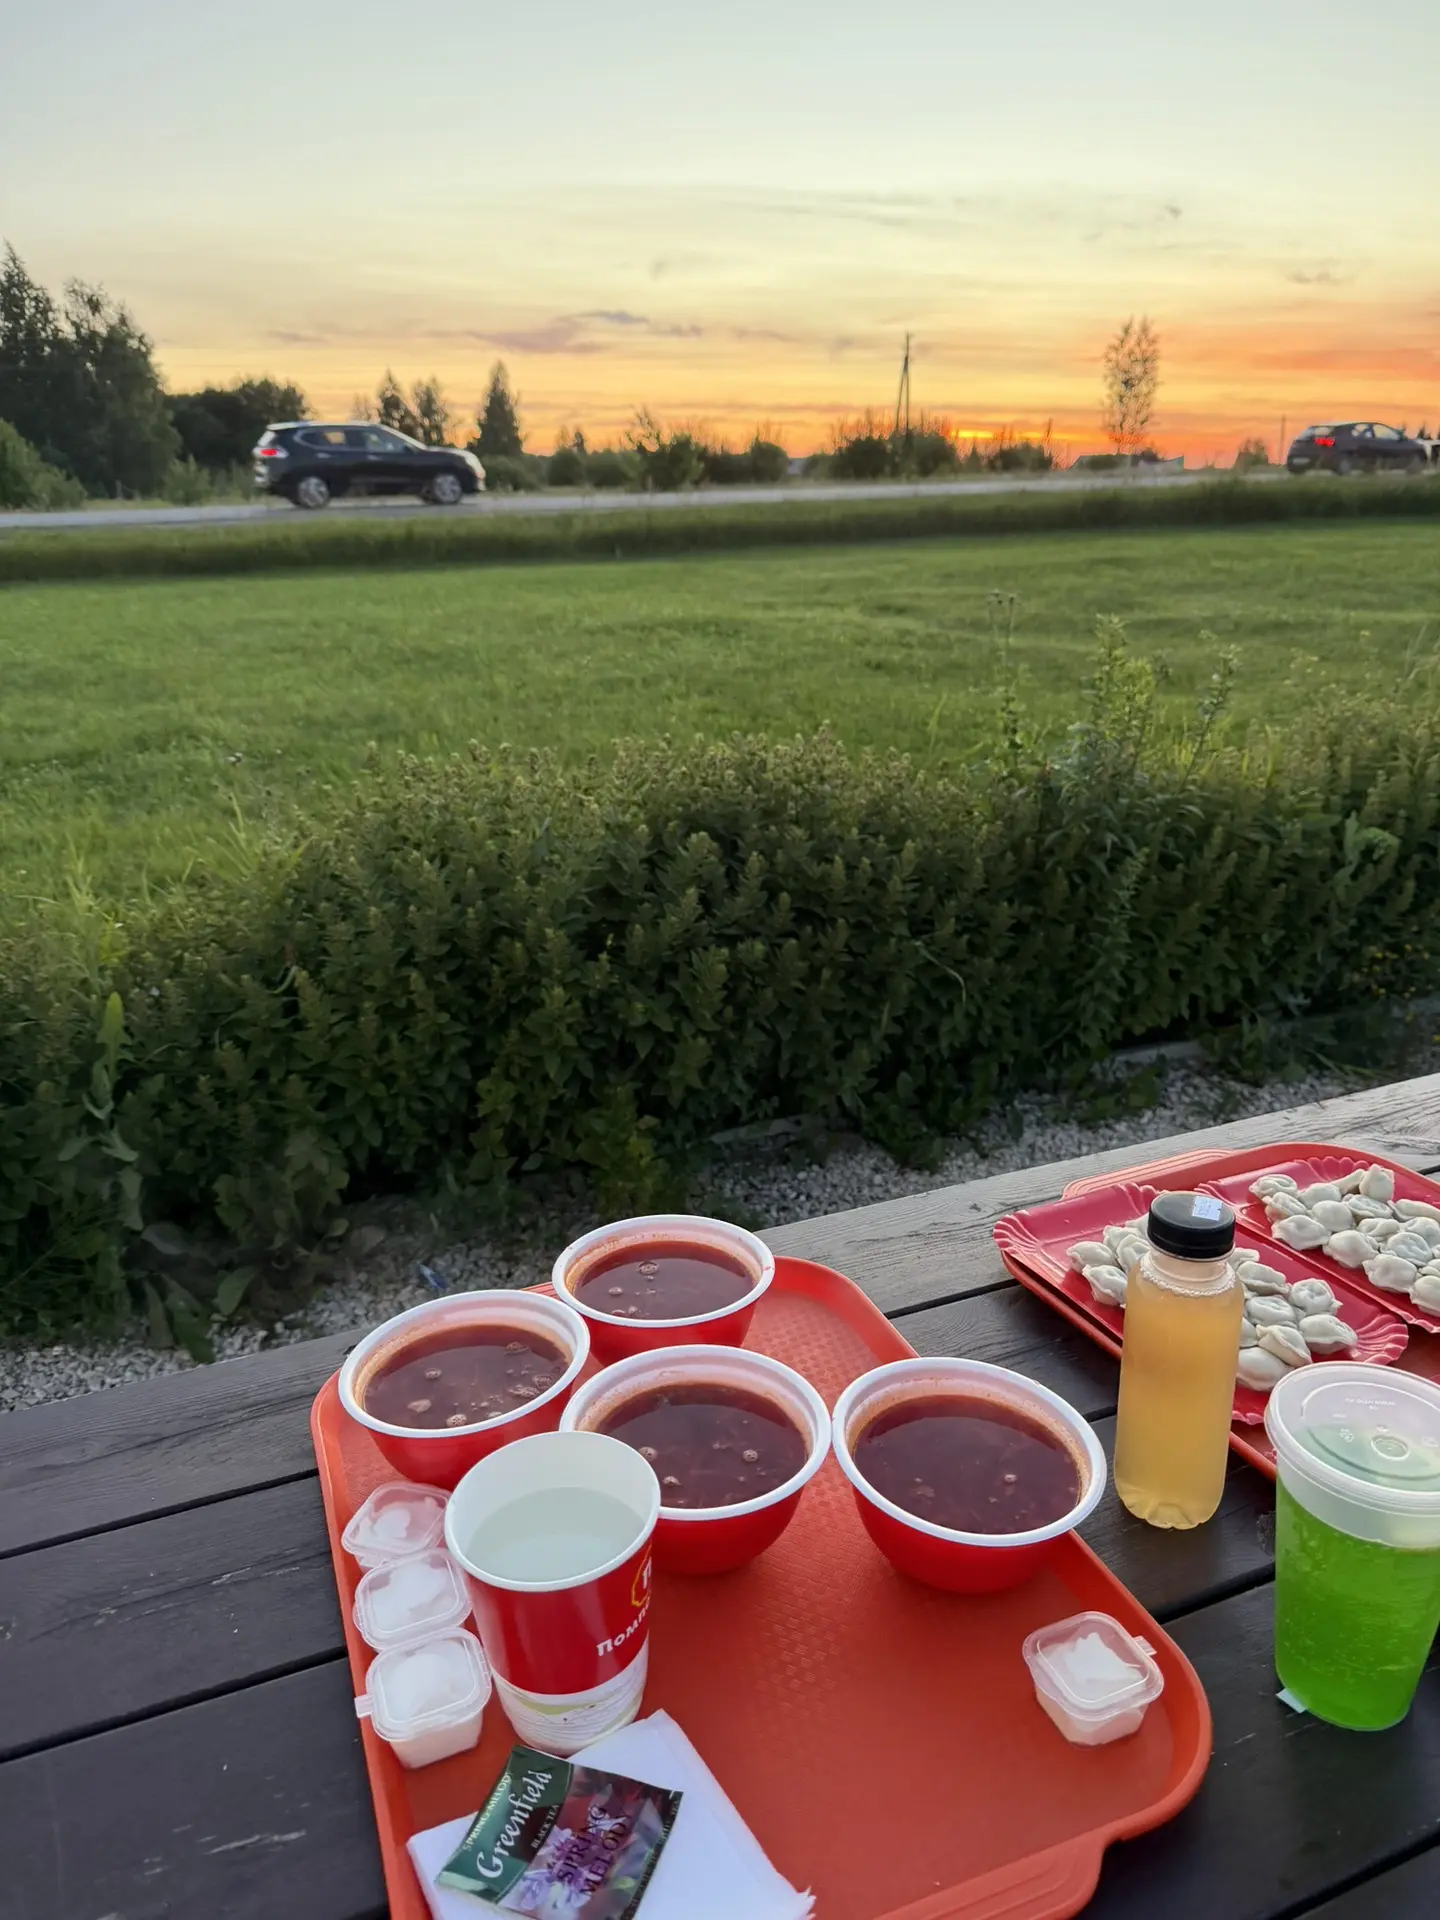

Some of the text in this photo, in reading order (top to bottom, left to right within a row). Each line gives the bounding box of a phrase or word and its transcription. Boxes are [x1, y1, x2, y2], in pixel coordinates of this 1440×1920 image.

[462, 1811, 491, 1852] SPRING
[477, 1770, 552, 1878] Greenfield
[531, 1804, 559, 1848] BLACK TEA
[556, 1804, 607, 1884] SPRING
